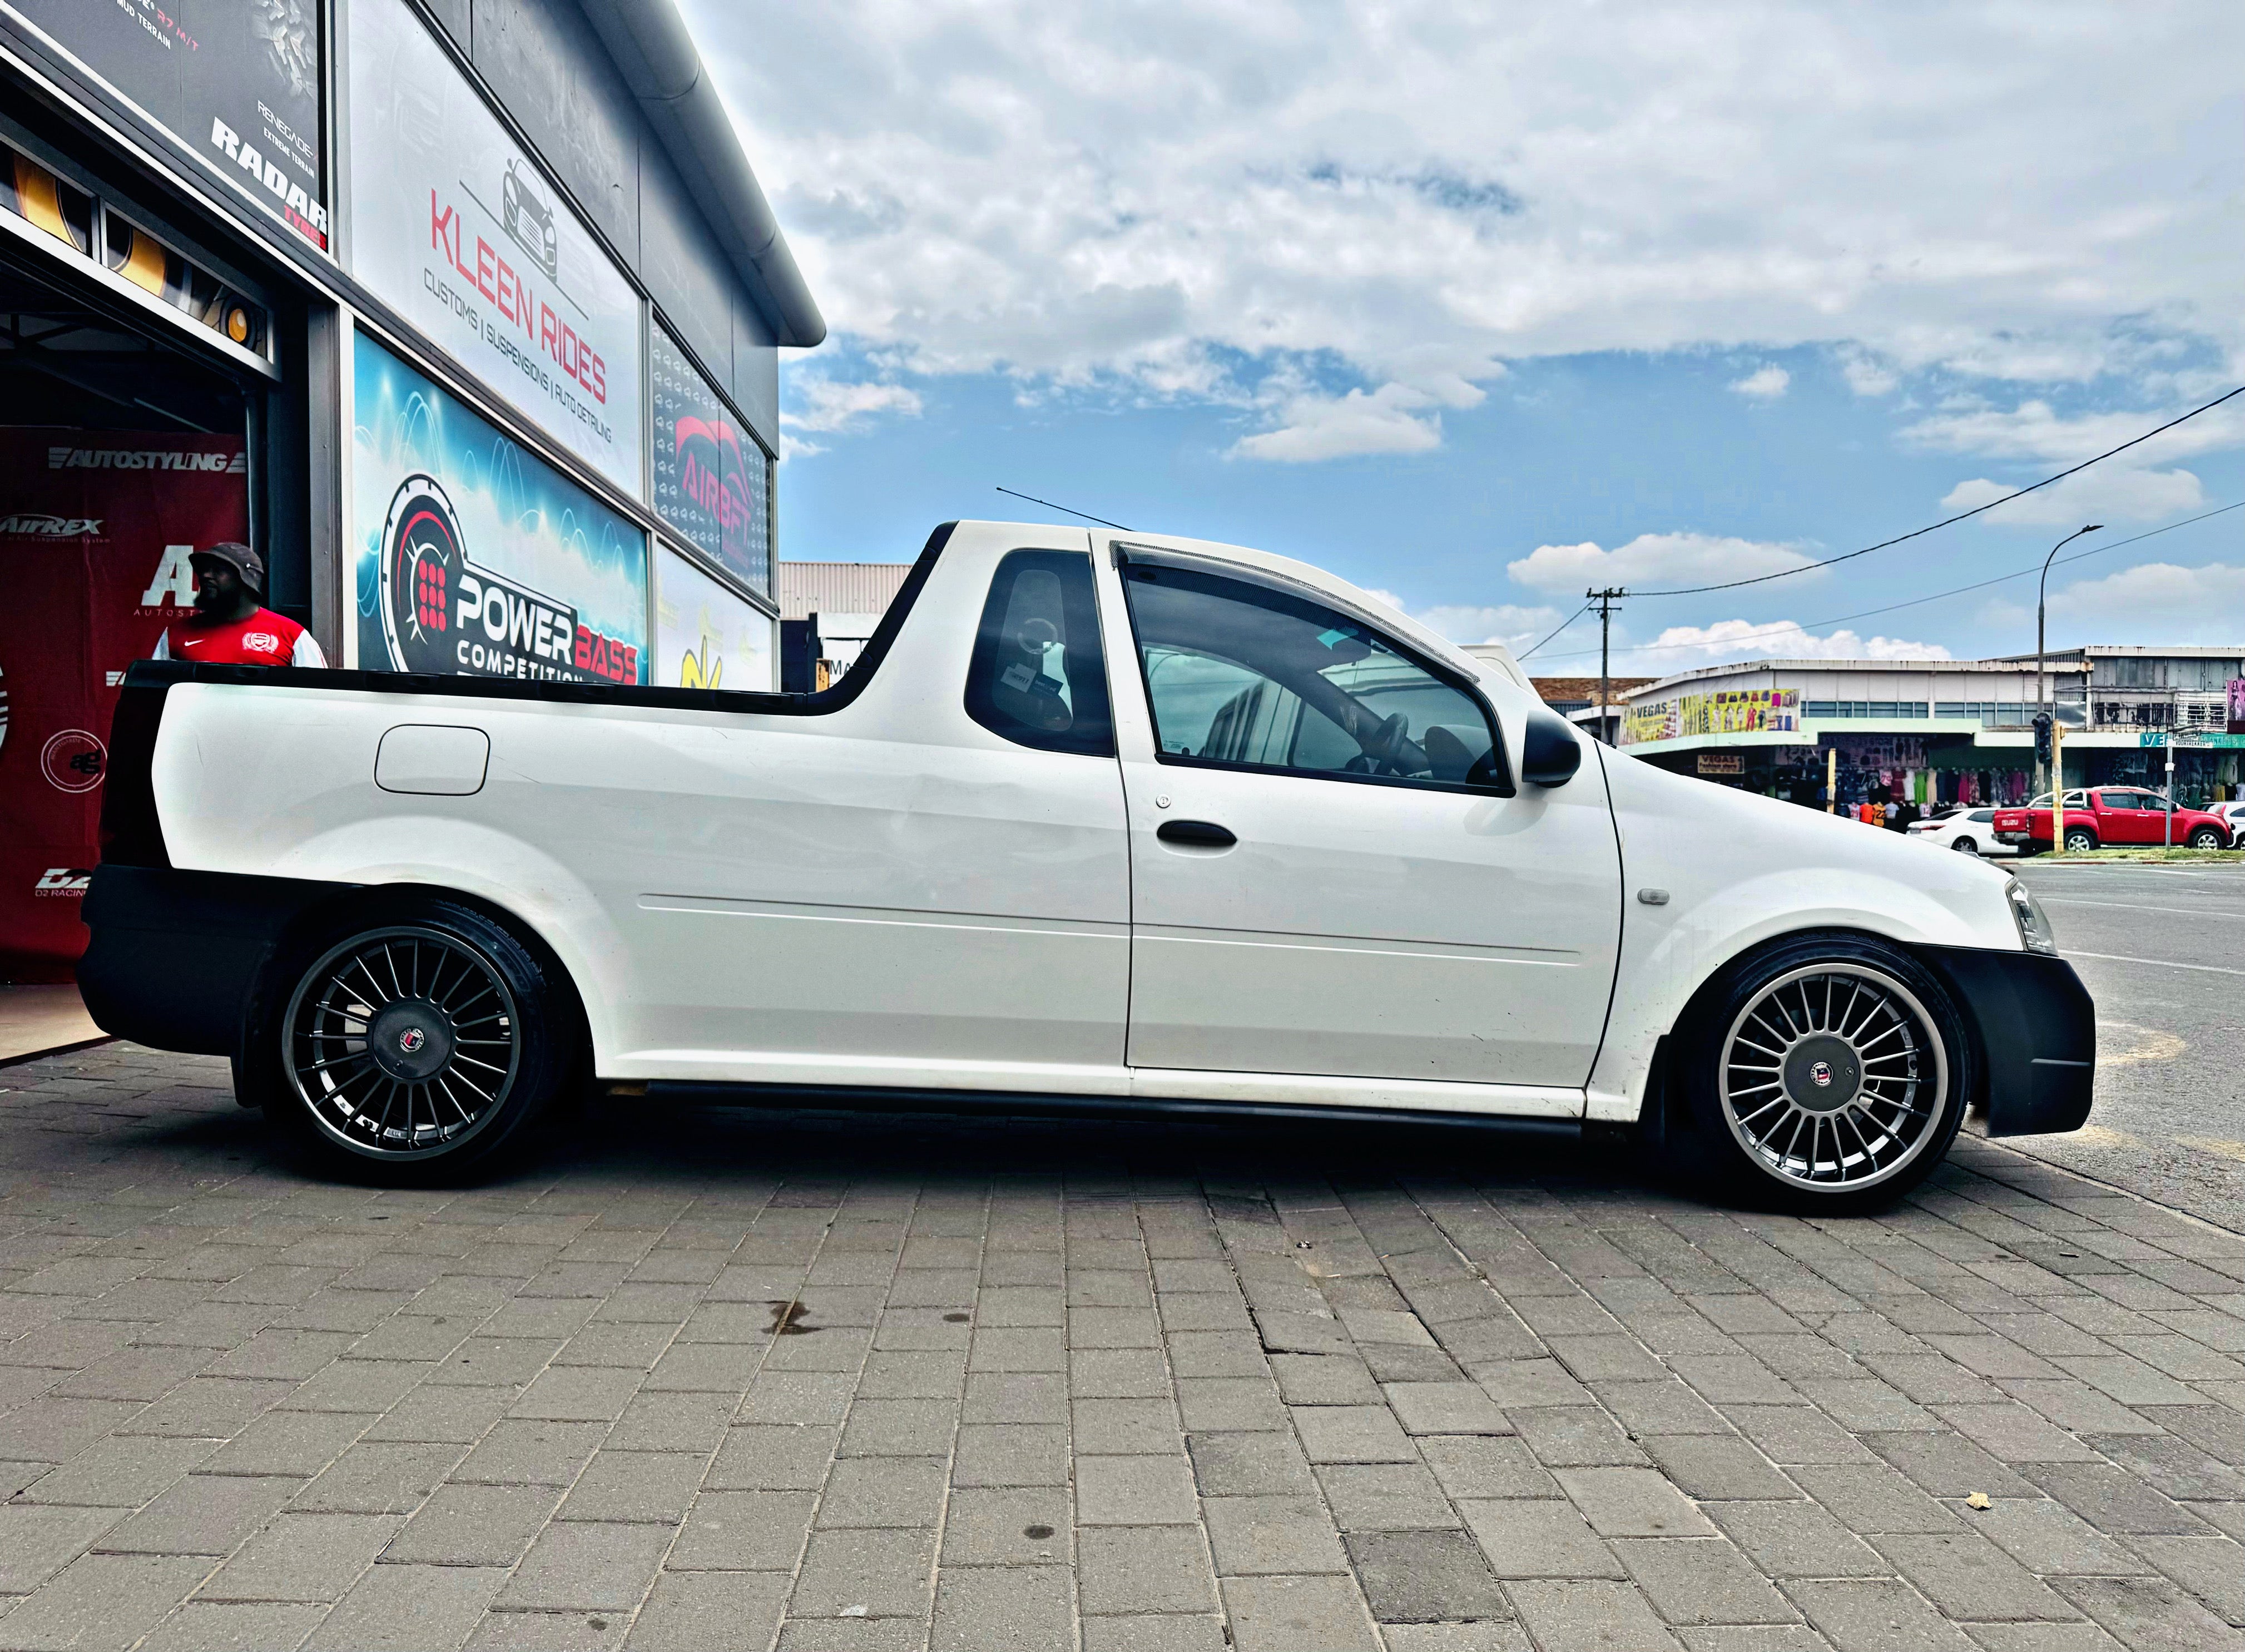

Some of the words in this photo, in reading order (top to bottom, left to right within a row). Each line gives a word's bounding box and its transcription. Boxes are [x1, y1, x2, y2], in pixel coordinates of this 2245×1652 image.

[116, 0, 135, 17] MUD
[137, 12, 171, 49] TERRAIN
[211, 116, 328, 236] RADAR
[264, 126, 290, 157] EXTREME
[291, 151, 315, 178] TERRAIN
[284, 205, 326, 250] TYRES
[431, 187, 533, 340] KLEEN
[541, 300, 606, 405] RIDES
[424, 267, 478, 331] CUSTOMS
[487, 323, 548, 391] SUSPENSIONS
[556, 384, 576, 414] AUTO
[577, 401, 612, 444] DETAILING
[66, 449, 227, 472] AUTOSTYLING
[682, 450, 751, 547] AIRBFT
[133, 608, 204, 617] AUTOST
[457, 574, 573, 666] POWER
[575, 623, 638, 686] BASS
[1637, 702, 1667, 718] VEGAS
